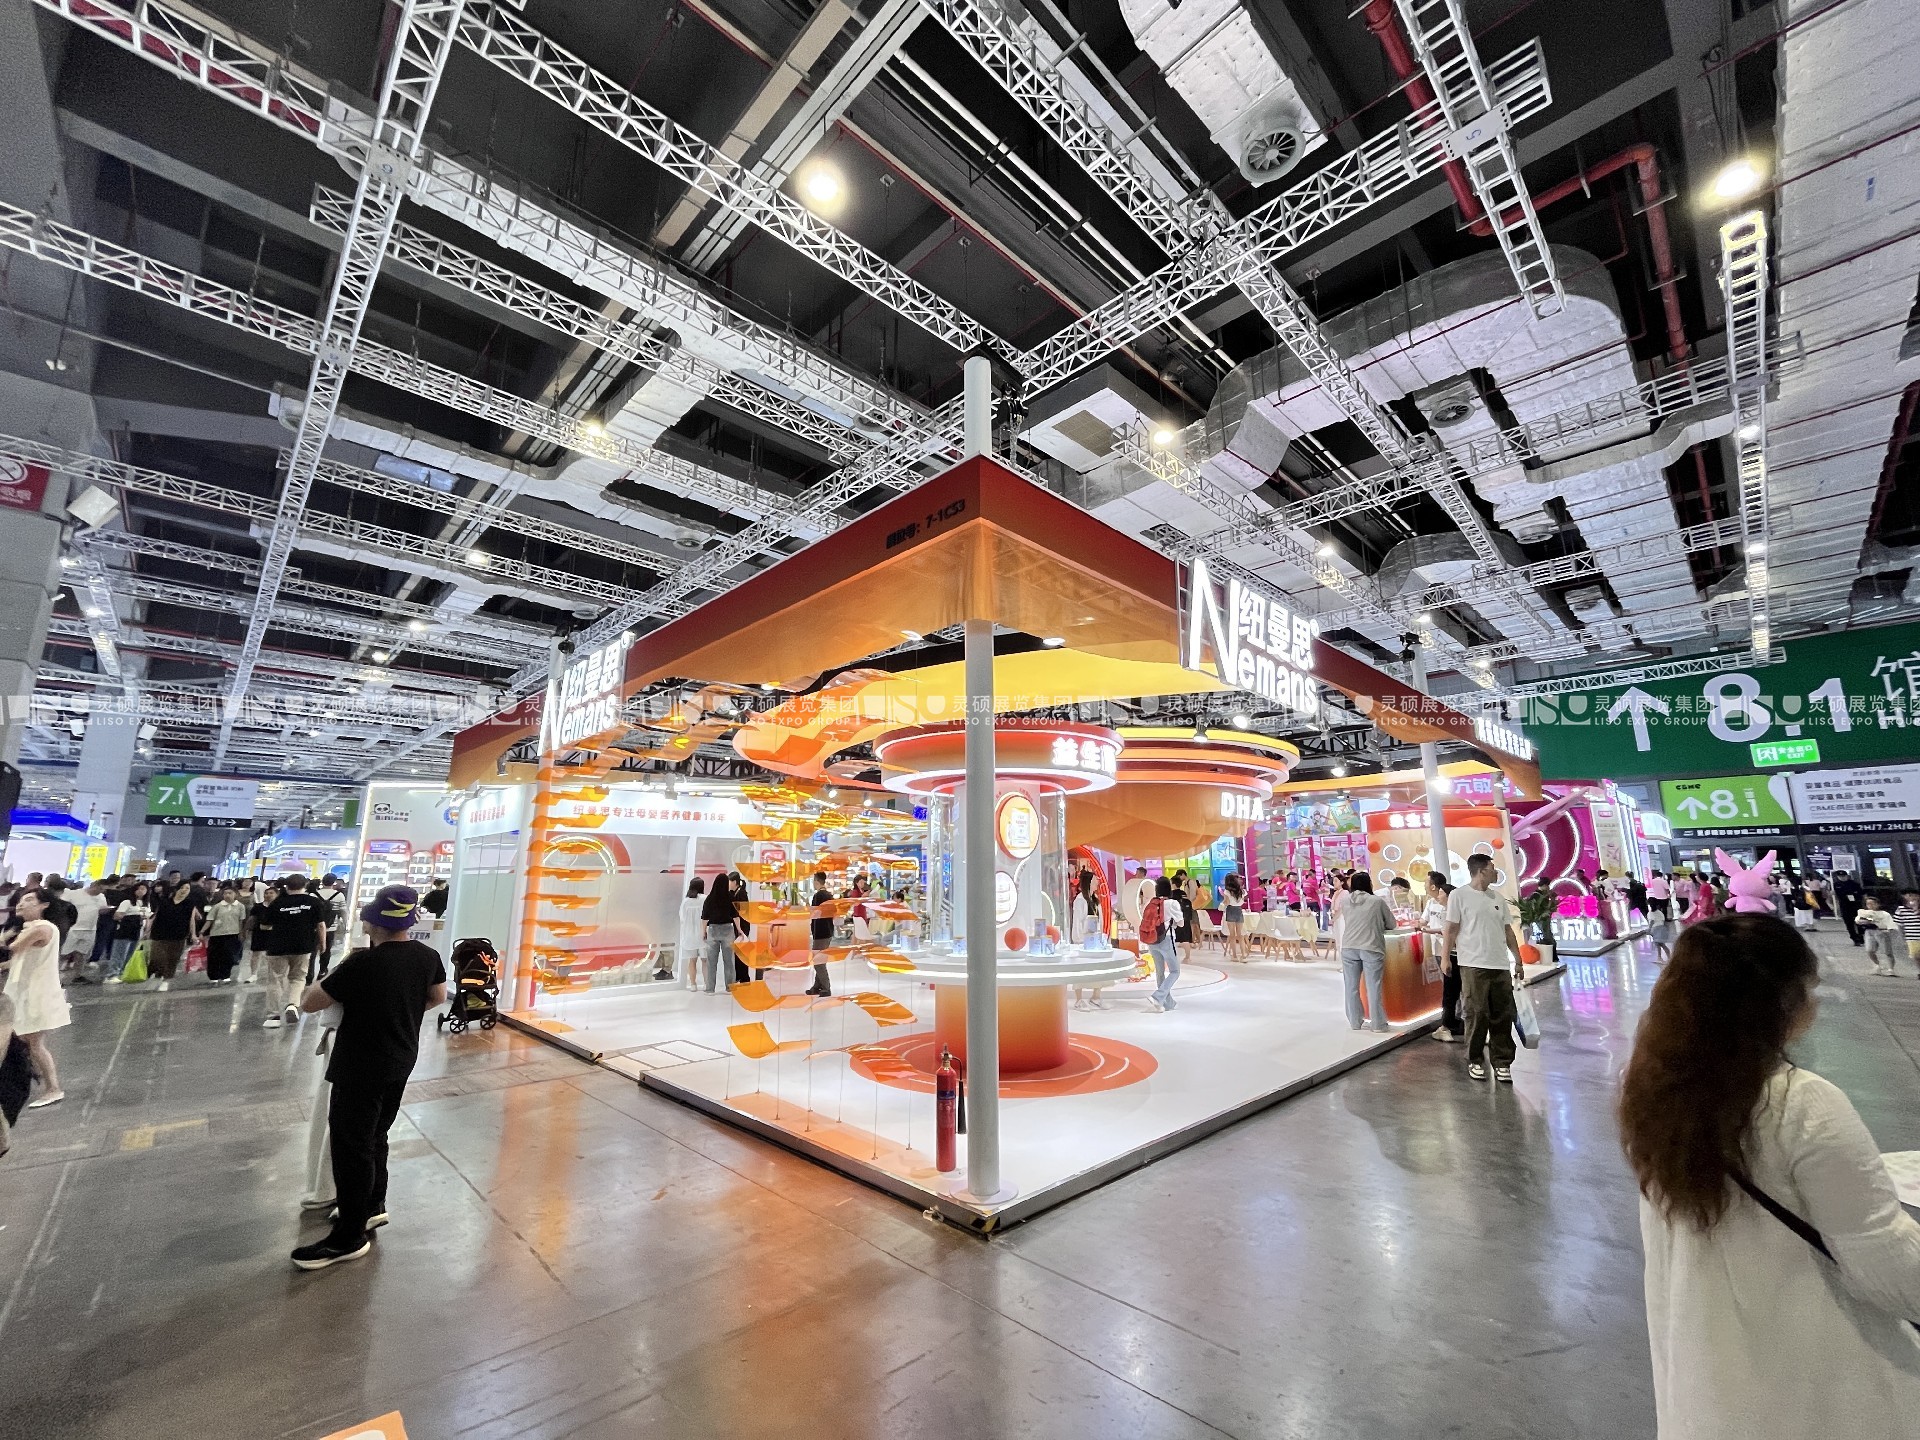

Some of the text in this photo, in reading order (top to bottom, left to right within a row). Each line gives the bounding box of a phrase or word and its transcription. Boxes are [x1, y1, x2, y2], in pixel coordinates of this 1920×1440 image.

[1188, 557, 1319, 714] Nemans
[1239, 586, 1315, 671] 纽曼思
[568, 641, 624, 708] 纽曼思
[1702, 672, 1852, 743] 8.1
[537, 669, 617, 757] Nemans
[157, 786, 185, 805] 7.1
[572, 804, 727, 823] 纽曼思专注母婴营养健康18年
[1219, 791, 1264, 821] DHA
[1709, 788, 1760, 819] 8.1
